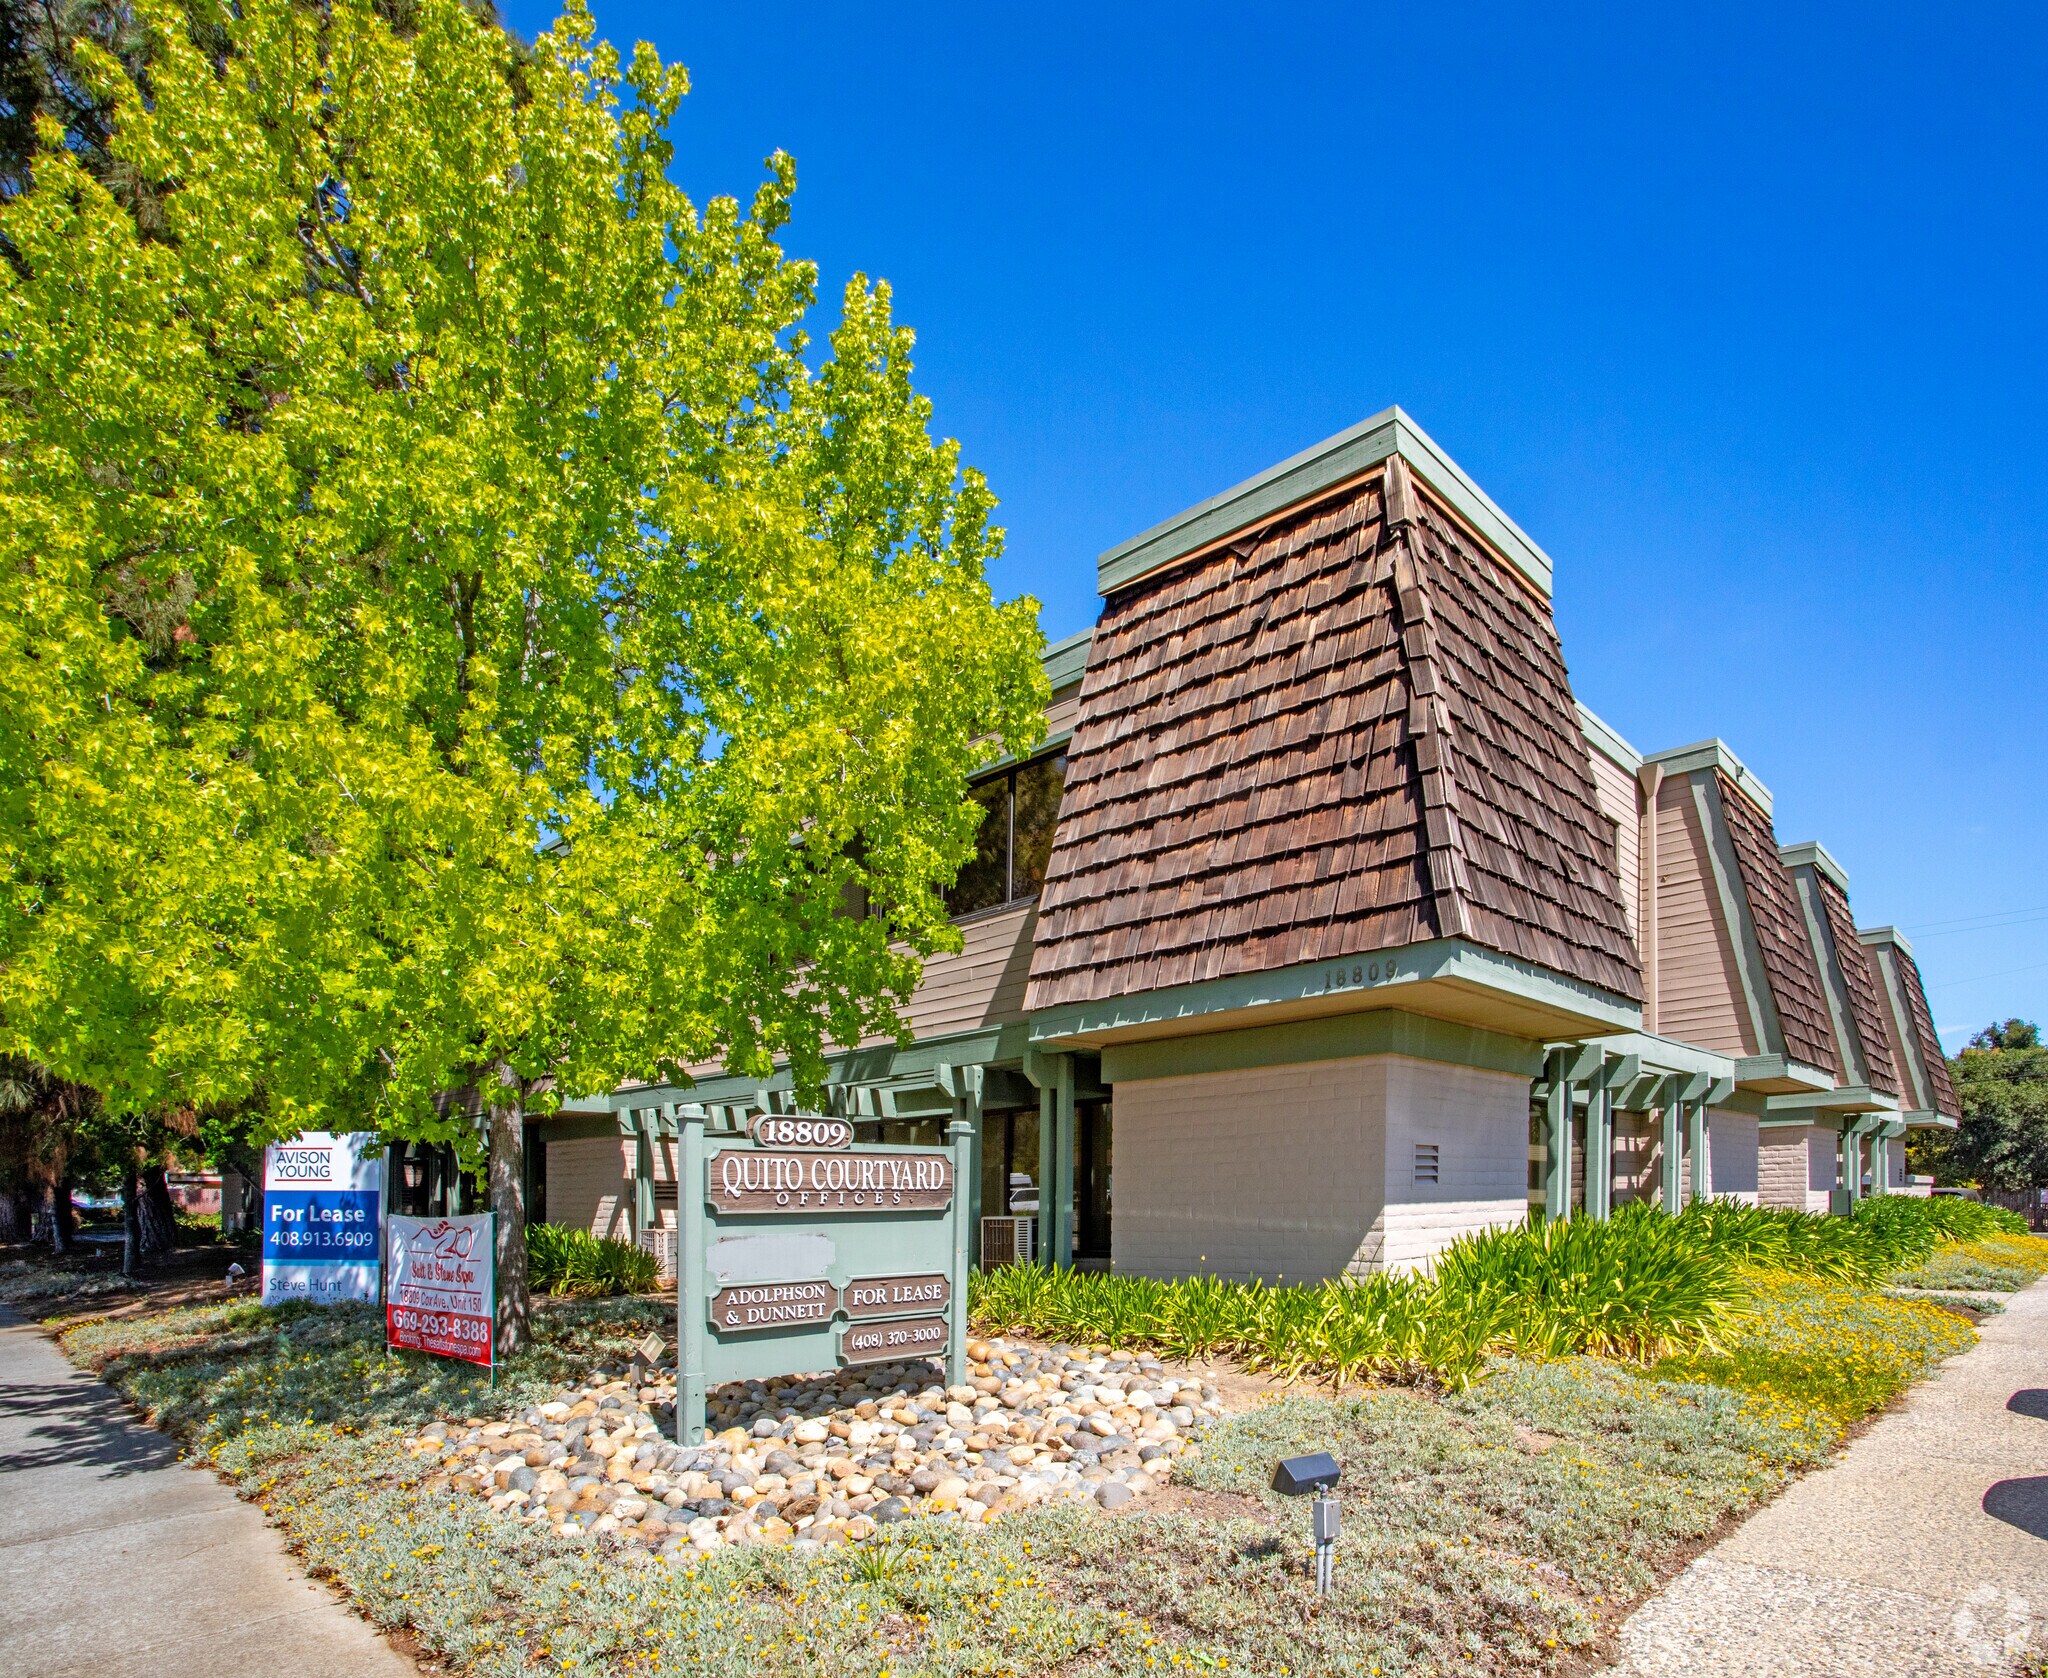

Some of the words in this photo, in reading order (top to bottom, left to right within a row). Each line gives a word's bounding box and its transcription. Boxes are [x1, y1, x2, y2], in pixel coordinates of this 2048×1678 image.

[1325, 959, 1397, 989] 18809
[765, 1120, 846, 1146] 18809
[276, 1152, 330, 1164] AVISON
[276, 1165, 330, 1178] YOUNG
[722, 1157, 803, 1197] QUITO
[811, 1159, 945, 1191] COURTYARD
[776, 1192, 901, 1206] OFFICES
[271, 1205, 304, 1222] For
[310, 1205, 365, 1222] Lease
[270, 1232, 373, 1247] 408.913.6909
[269, 1278, 306, 1291] Steve
[309, 1279, 342, 1292] Hunt
[412, 1261, 426, 1279] Salt
[427, 1263, 433, 1280] &
[435, 1262, 454, 1283] Stone
[456, 1264, 475, 1289] Spa
[400, 1289, 420, 1304] 18809
[421, 1292, 432, 1306] Cox
[434, 1294, 450, 1311] Ave,
[450, 1295, 466, 1310] Unit
[469, 1297, 481, 1312] 150
[726, 1284, 826, 1306] ADOLPHSON
[853, 1288, 887, 1306] FOR
[893, 1285, 942, 1304] LEASE
[393, 1309, 488, 1343] 669-293-8388
[726, 1311, 741, 1326] &
[748, 1303, 826, 1323] DUNNETT
[422, 1334, 482, 1357] Thesaltstonespa.com
[851, 1332, 883, 1351] (408)
[887, 1327, 941, 1347] 370-3000
